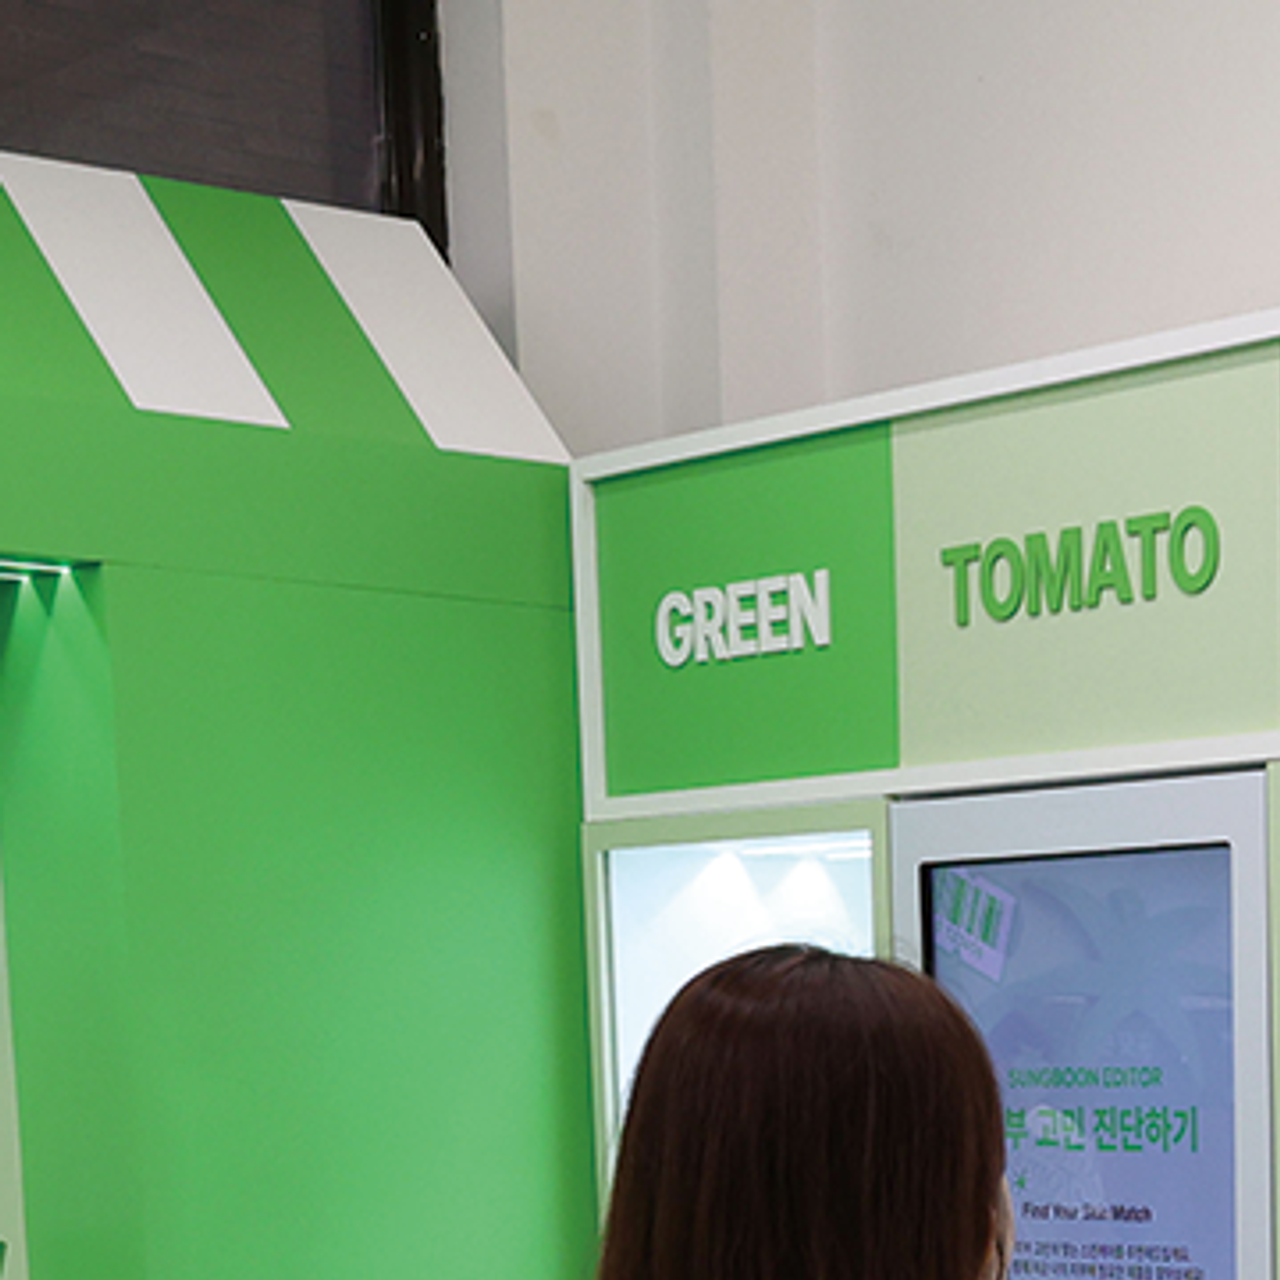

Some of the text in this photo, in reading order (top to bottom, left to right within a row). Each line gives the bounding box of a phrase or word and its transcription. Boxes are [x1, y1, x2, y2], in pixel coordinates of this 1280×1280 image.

[655, 568, 832, 668] GREEN
[941, 505, 1220, 627] TOMATO
[1008, 1066, 1163, 1089] SUNGBOON EDITOR
[1005, 1106, 1198, 1153] 부 고민 진단하기
